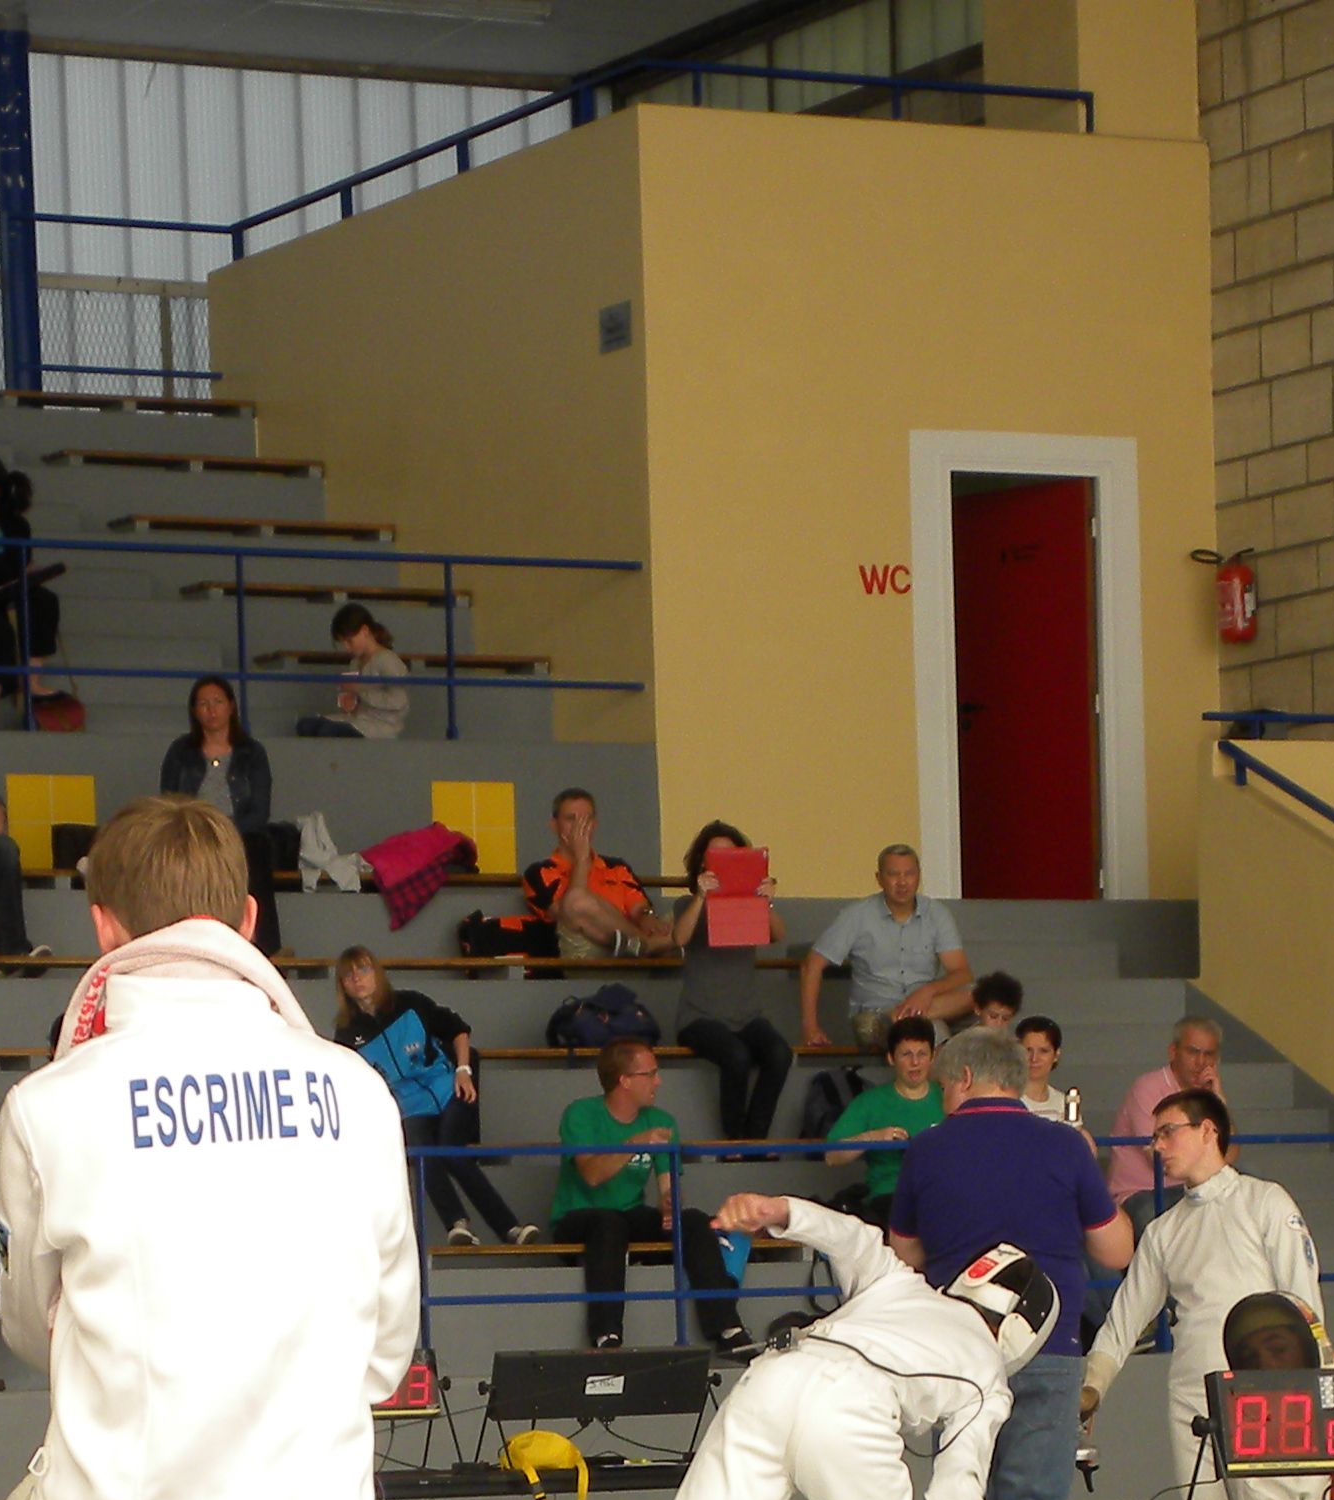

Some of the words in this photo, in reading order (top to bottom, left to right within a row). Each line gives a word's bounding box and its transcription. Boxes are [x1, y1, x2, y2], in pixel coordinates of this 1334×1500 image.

[858, 564, 911, 595] WC
[129, 1069, 298, 1149] ESCRIME
[305, 1071, 340, 1141] 50
[1235, 1394, 1312, 1455] 07
